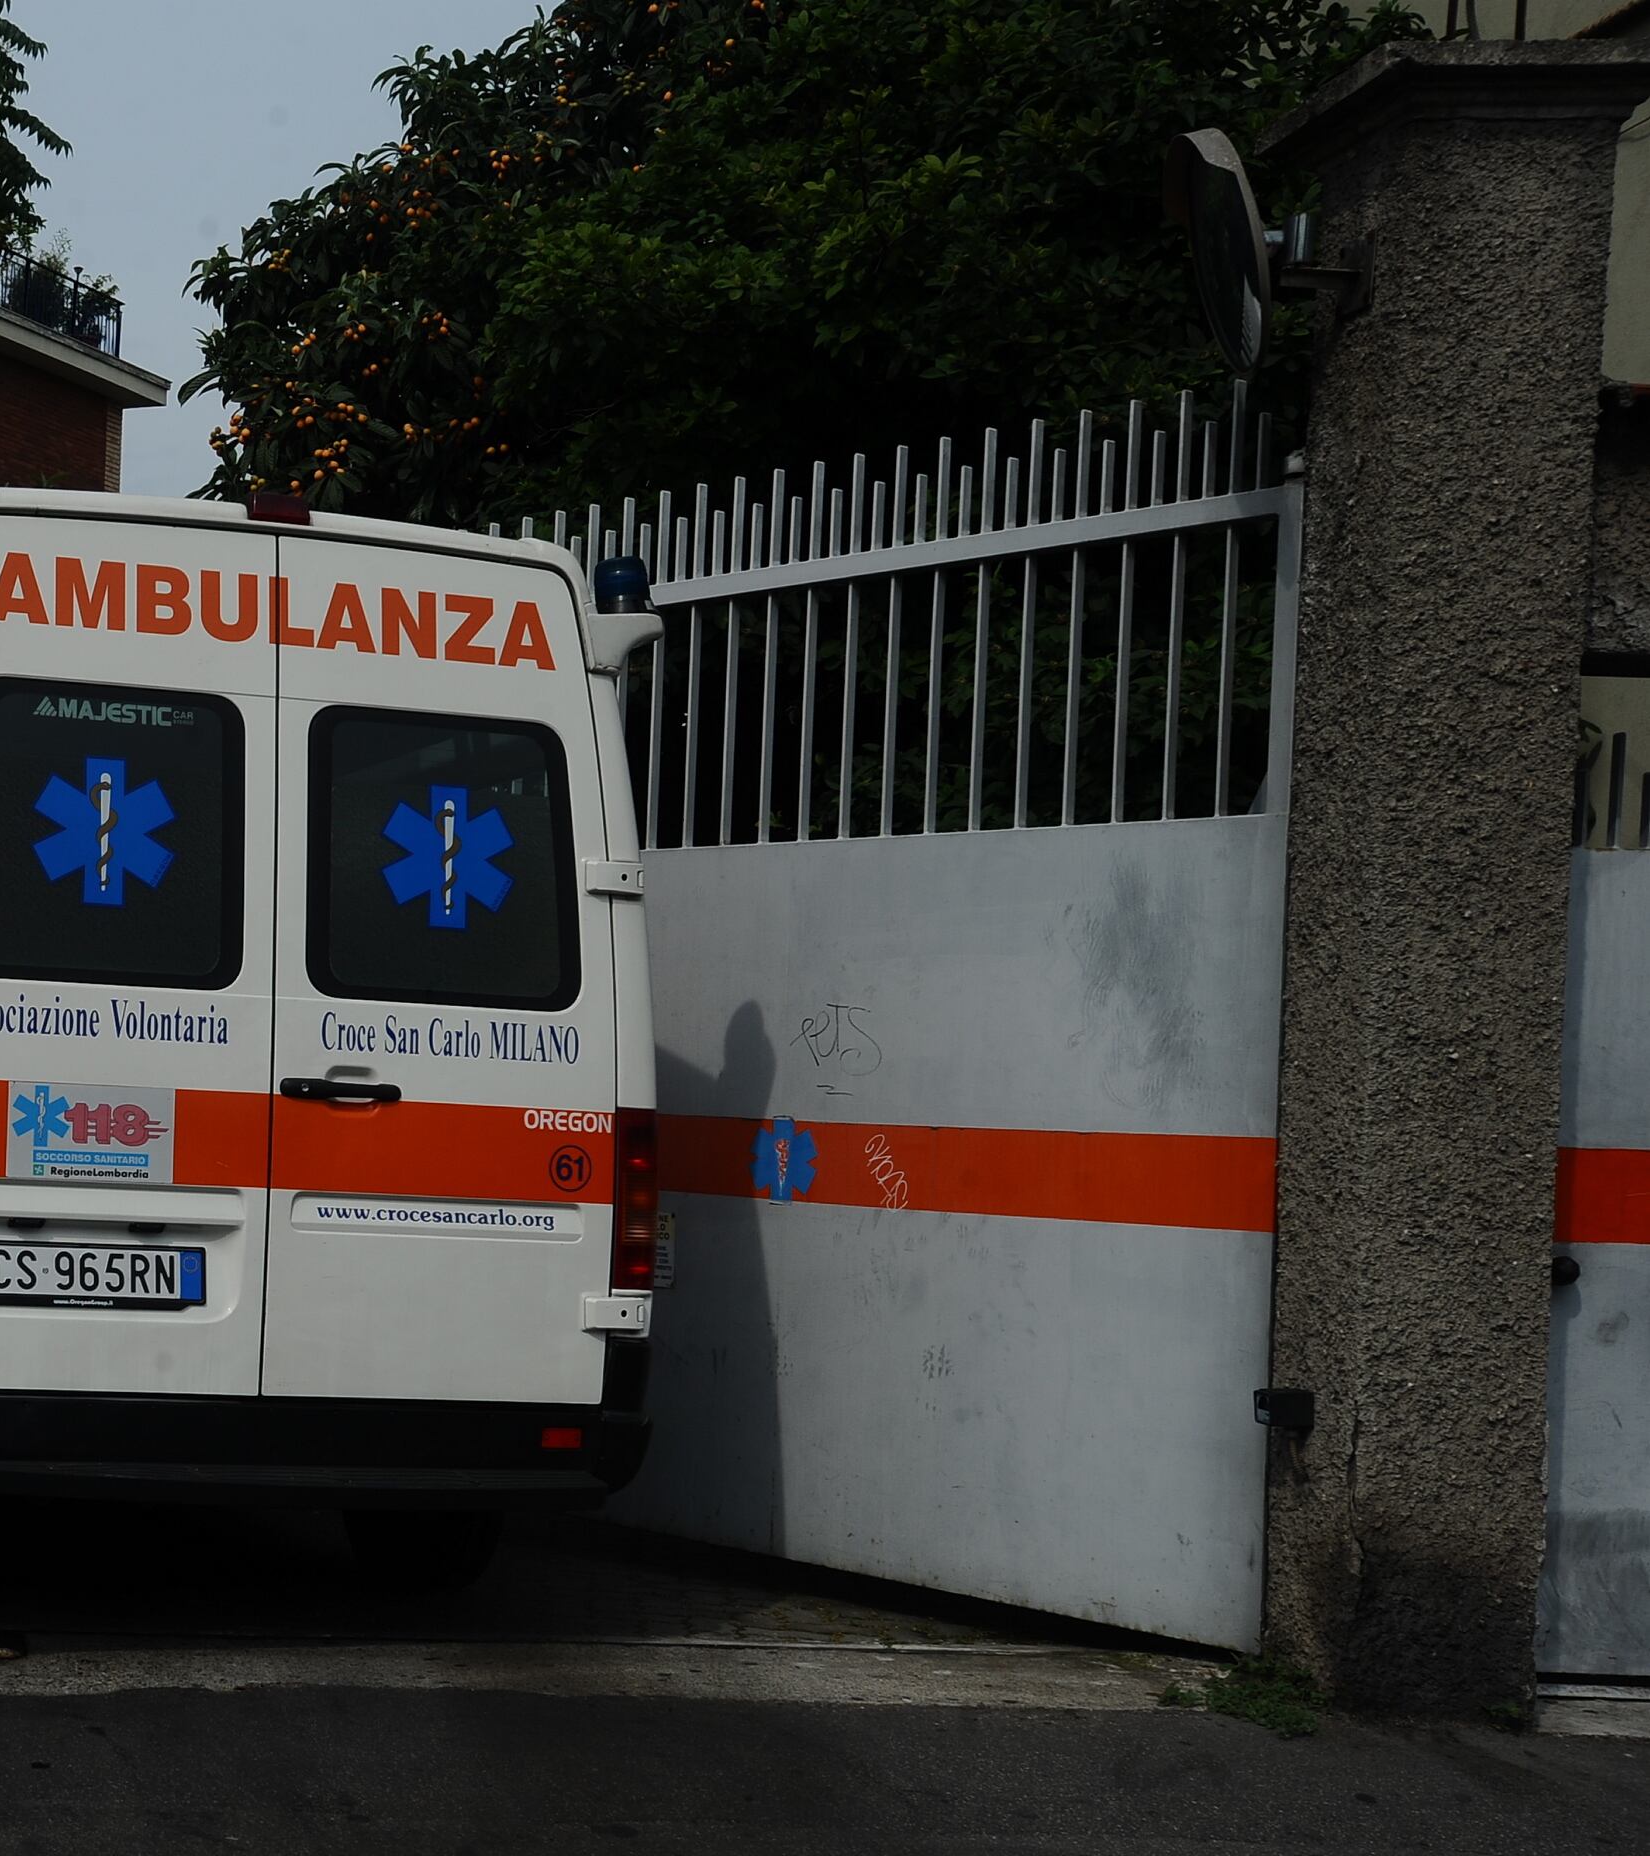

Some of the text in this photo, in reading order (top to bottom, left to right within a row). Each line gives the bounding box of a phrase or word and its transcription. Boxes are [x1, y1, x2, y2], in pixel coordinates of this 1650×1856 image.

[58, 697, 194, 727] MAJESTIC CAR
[109, 999, 228, 1045] Volontaria
[321, 1011, 580, 1065] Croce San Carlo MILANO
[64, 1102, 158, 1146] 118
[523, 1109, 612, 1134] OREGON
[34, 1152, 146, 1166] SOCCORSO SANITARIO
[50, 1166, 149, 1180] RegioneLombardia
[555, 1154, 585, 1183] 61
[317, 1204, 556, 1231] www.crocesancarlo.org
[54, 1250, 176, 1295] 965RN
